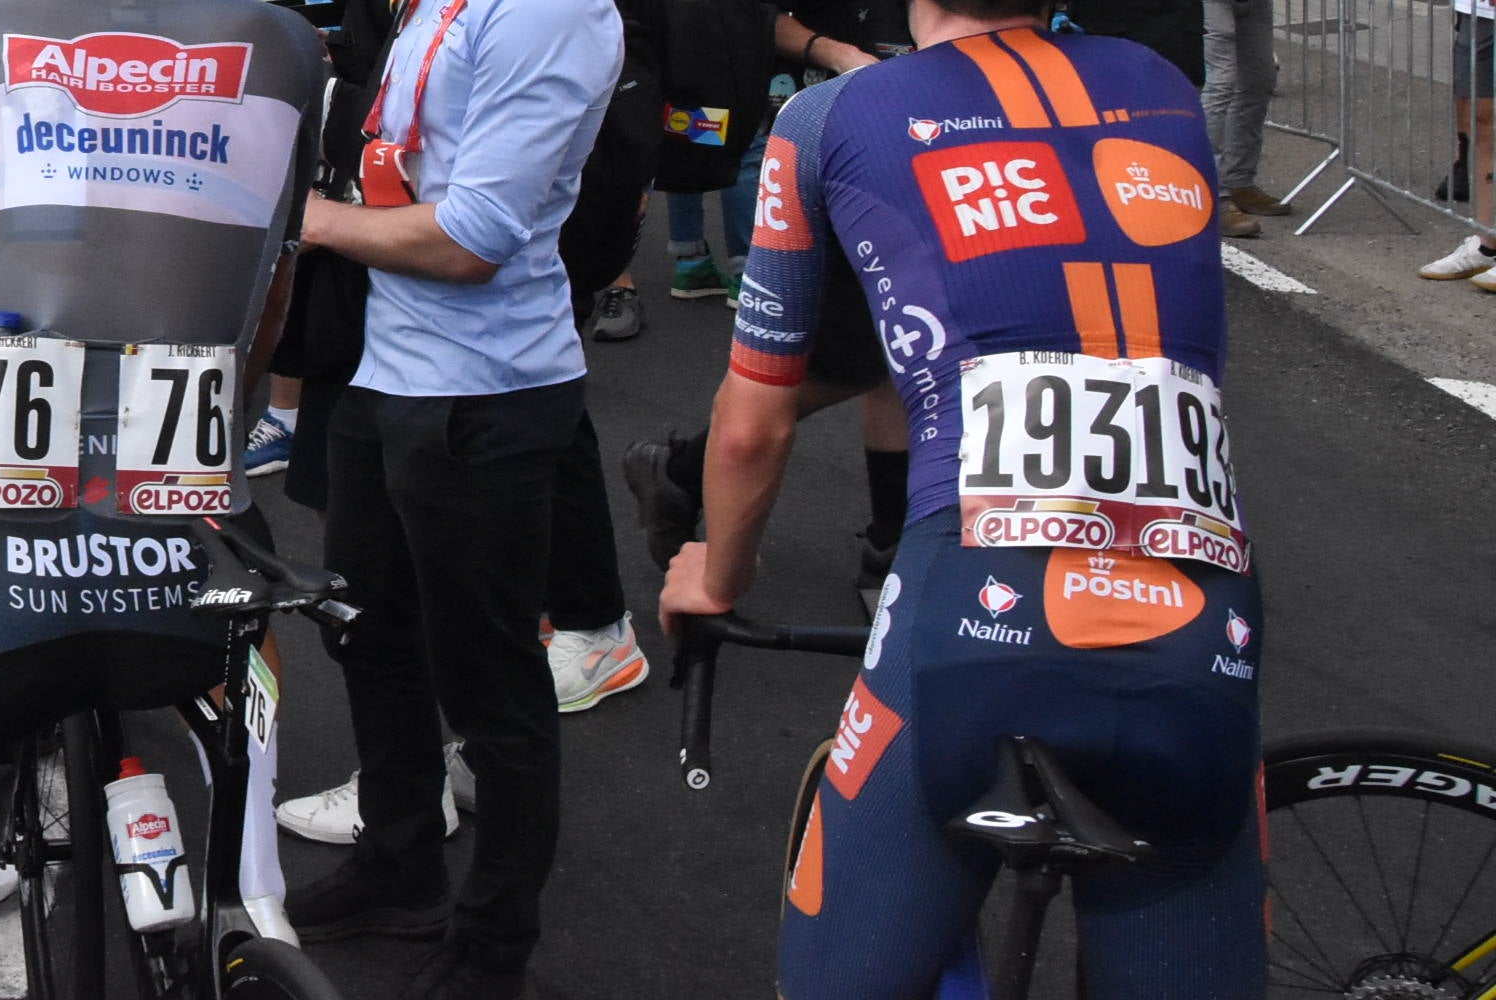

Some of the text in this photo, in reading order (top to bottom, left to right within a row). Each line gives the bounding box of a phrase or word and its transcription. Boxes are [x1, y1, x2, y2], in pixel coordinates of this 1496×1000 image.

[31, 69, 216, 93] HAIR BOOSTER
[32, 44, 218, 90] Alpecin
[17, 112, 232, 164] deceuninck
[944, 116, 1004, 133] Nalini
[67, 166, 175, 186] WINDOWS
[1115, 180, 1202, 210] postnl
[857, 240, 896, 311] eyes
[1019, 351, 1075, 365] B. KOERDT
[151, 368, 227, 467] 76
[912, 367, 939, 442] more
[965, 375, 1131, 494] 193
[7, 534, 197, 578] BRUSTOR
[9, 581, 199, 613] SUN SYSTEMS
[1063, 572, 1184, 608] postnl
[958, 618, 1032, 646] Nalini
[248, 676, 265, 744] 76
